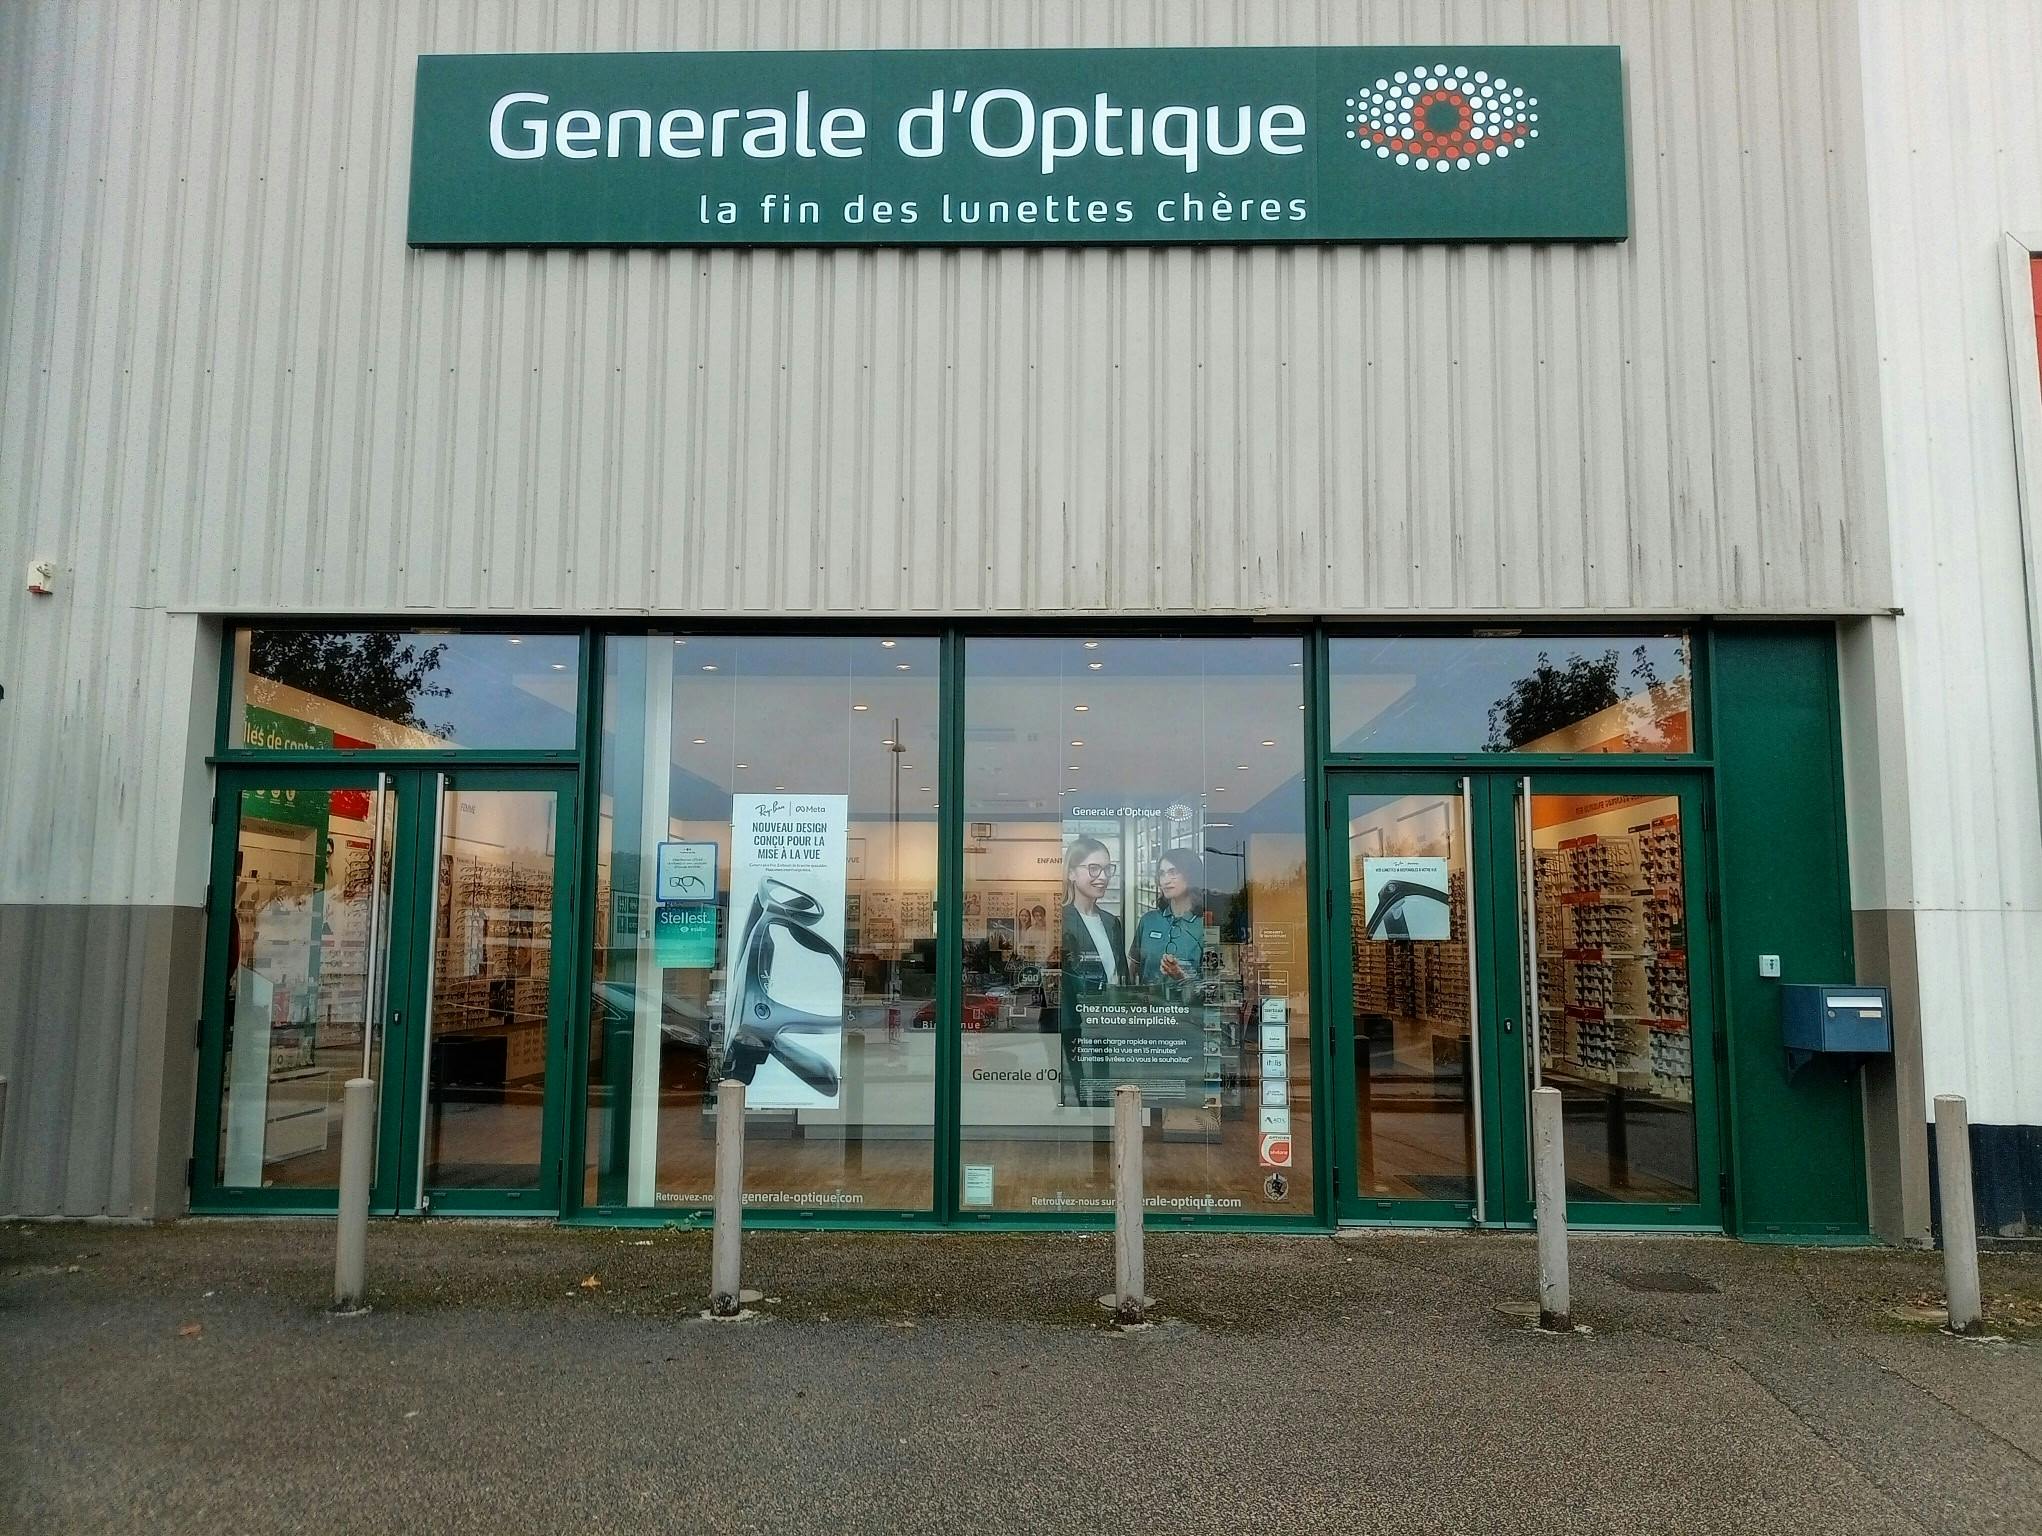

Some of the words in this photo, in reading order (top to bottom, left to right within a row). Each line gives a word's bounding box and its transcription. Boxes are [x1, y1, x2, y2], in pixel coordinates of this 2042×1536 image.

[489, 89, 867, 159] Generale
[897, 88, 1308, 174] d'Optique
[699, 194, 738, 224] la
[760, 193, 820, 224] fin
[843, 193, 918, 224] des
[941, 193, 1134, 223] lunettes
[1156, 191, 1308, 222] chères
[267, 729, 282, 750] de
[755, 800, 785, 817] Ray-Ban
[805, 805, 826, 813] Meta
[1072, 806, 1115, 816] Generale
[1116, 806, 1161, 818] d'Optique
[752, 822, 793, 833] NOUVEAU
[796, 822, 827, 833] DESIGN
[753, 835, 784, 848] CONÇU
[787, 835, 811, 846] POUR
[814, 836, 825, 846] LA
[757, 848, 779, 859] MISE
[780, 846, 788, 859] À
[790, 849, 801, 859] LA
[803, 849, 821, 860] VUE
[1022, 973, 1039, 983] 500
[1075, 1004, 1100, 1013] Chez
[1102, 1006, 1129, 1014] nous,
[1149, 1004, 1190, 1014] lunettes
[1086, 1017, 1099, 1025] en
[1100, 1016, 1127, 1025] toute
[1128, 1015, 1179, 1027] simplicité.
[1103, 1038, 1126, 1046] charge
[1126, 1038, 1147, 1047] rapide
[1158, 1039, 1187, 1047] magasin
[1126, 1055, 1135, 1063] où
[972, 1068, 1032, 1081] Generale
[656, 1192, 714, 1201] Retrouvez-no
[741, 1190, 863, 1205] generale-optique.com
[1031, 1196, 1100, 1206] Retrouvez-nous
[1143, 1194, 1242, 1209] rale-optique.com
